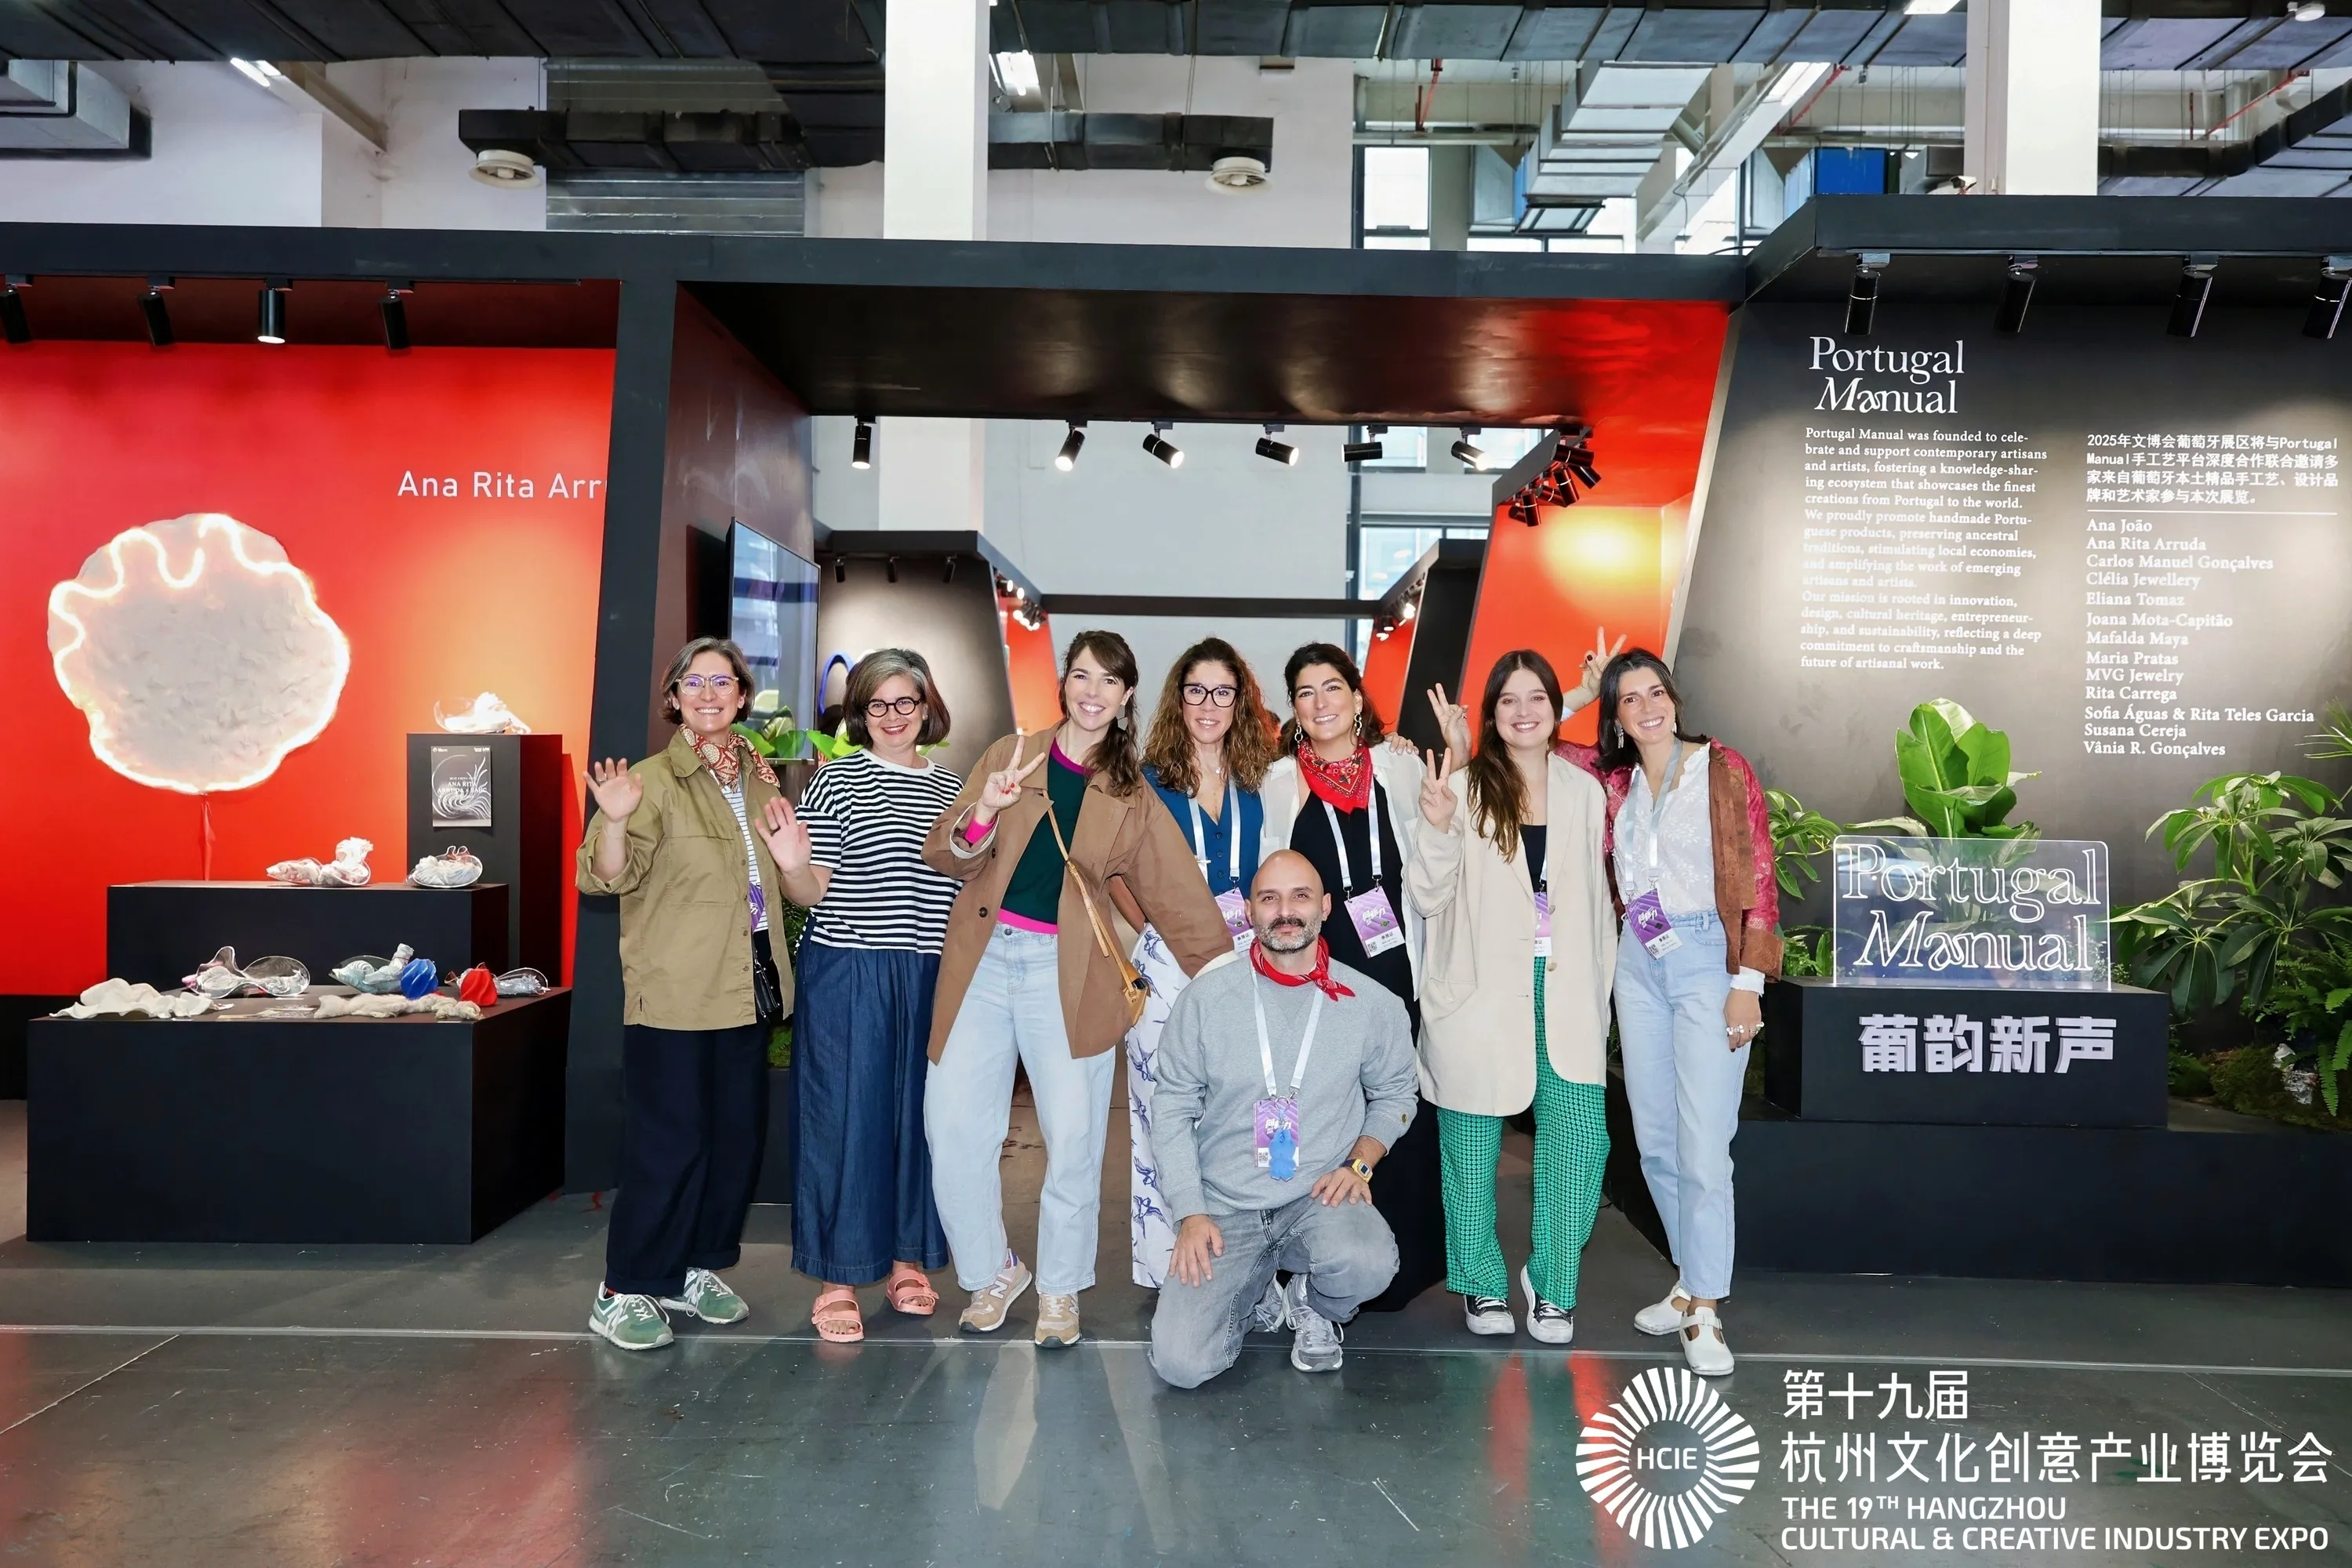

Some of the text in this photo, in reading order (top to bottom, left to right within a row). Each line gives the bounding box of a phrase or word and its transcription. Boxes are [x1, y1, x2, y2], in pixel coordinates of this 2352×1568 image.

[1808, 336, 1965, 385] Portugal
[1814, 377, 1958, 414] Manual
[1805, 427, 1855, 443] Portugal
[1858, 428, 1904, 440] Manual
[1933, 430, 1982, 441] founded
[1985, 430, 1998, 442] to
[2000, 431, 2028, 442] cele-
[1805, 444, 2047, 462] brate and support contemporary artisans
[1804, 460, 1827, 471] and
[1830, 460, 1870, 474] artists,
[1874, 461, 1927, 477] fostering
[1940, 463, 2038, 479] knowledge-shar-
[397, 470, 607, 499] Ana Rita Arr
[1806, 477, 2035, 492] ing ecosystem that showcases the finest
[1805, 493, 2023, 510] creations from Portugal to the world.
[1875, 511, 1926, 526] promote
[1928, 512, 1991, 524] handmade
[1994, 514, 2032, 525] Portu-
[1839, 527, 1896, 543] products,
[1899, 528, 1962, 543] preserving
[1965, 529, 2018, 541] ancestral
[2086, 520, 2152, 535] Ana João
[1938, 545, 1966, 556] local
[1969, 545, 2036, 559] economies,
[2085, 537, 2207, 550] Ana Rita Arruda
[1895, 561, 1914, 572] the
[1918, 561, 1947, 572] work
[1951, 561, 1962, 572] of
[1965, 561, 2021, 577] emerging
[2086, 555, 2273, 572] Carlos Manuel Gonçalves
[2087, 574, 2201, 590] Clélia Jewellery
[1949, 593, 2017, 608] innovation,
[2086, 593, 2184, 606] Eliana Tomaz
[1896, 608, 1947, 624] heritage,
[1951, 610, 2034, 626] entrepreneur-
[2086, 613, 2233, 630] Joana Mota-Capitão
[1800, 623, 1829, 638] ship,
[1832, 624, 1855, 635] and
[1858, 624, 1940, 641] sustainability,
[1944, 626, 2000, 641] reflecting
[2013, 627, 2042, 642] deep
[2085, 633, 2189, 648] Mafalda Maya
[1799, 640, 2024, 658] commitment to craftsmanship and the
[1800, 656, 1944, 670] future of artisanal work.
[2085, 652, 2179, 666] Maria Pratas
[2085, 670, 2183, 685] MVG Jewelry
[2085, 688, 2177, 703] Rita Carrega
[2084, 704, 2314, 724] Sofia Águas & Rita Teles Garcia
[2084, 724, 2186, 741] Susana Cereja
[2083, 742, 2226, 759] Vânia R. Gonçalves
[1842, 843, 2101, 923] Portugal
[1853, 909, 2092, 971] Manual
[1858, 1014, 2117, 1073] 葡韵新声
